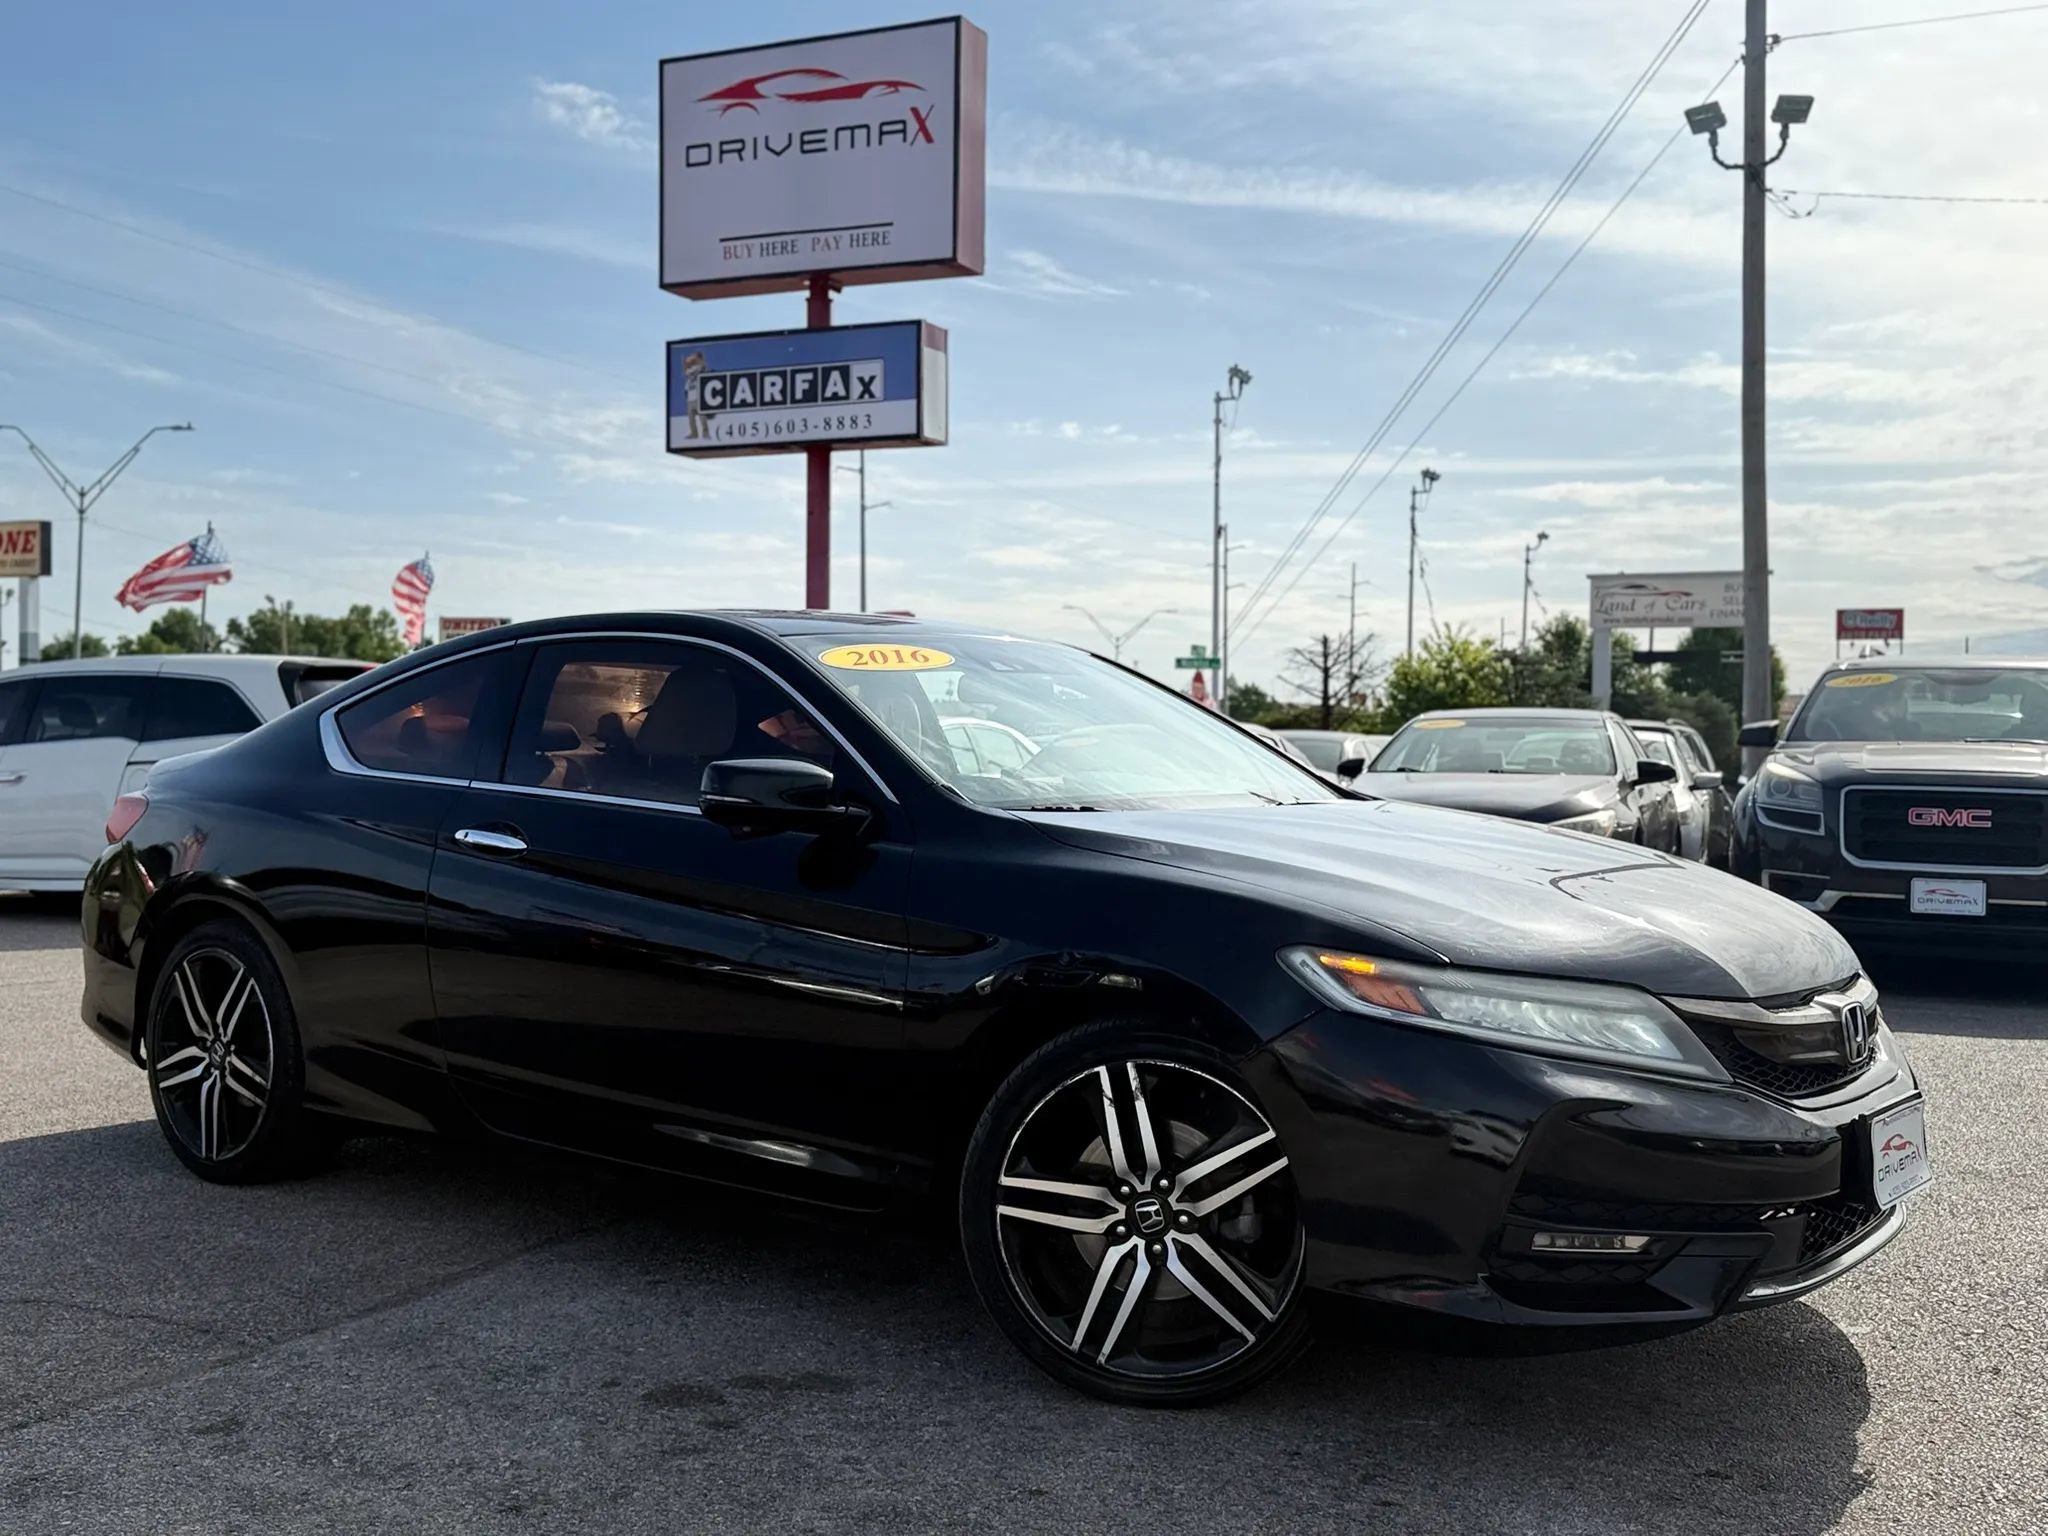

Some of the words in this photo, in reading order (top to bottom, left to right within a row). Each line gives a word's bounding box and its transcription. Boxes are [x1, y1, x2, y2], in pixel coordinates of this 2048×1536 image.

[685, 104, 935, 168] DRIVEMAX
[722, 243, 756, 261] BUY
[759, 239, 799, 258] HERE
[811, 234, 843, 253] PAY
[849, 230, 891, 249] HERE
[703, 369, 878, 406] CARFAX
[715, 413, 873, 441] (405)603-8883
[0, 530, 37, 554] NE
[846, 649, 930, 666] 2016
[1908, 807, 1992, 828] GMC
